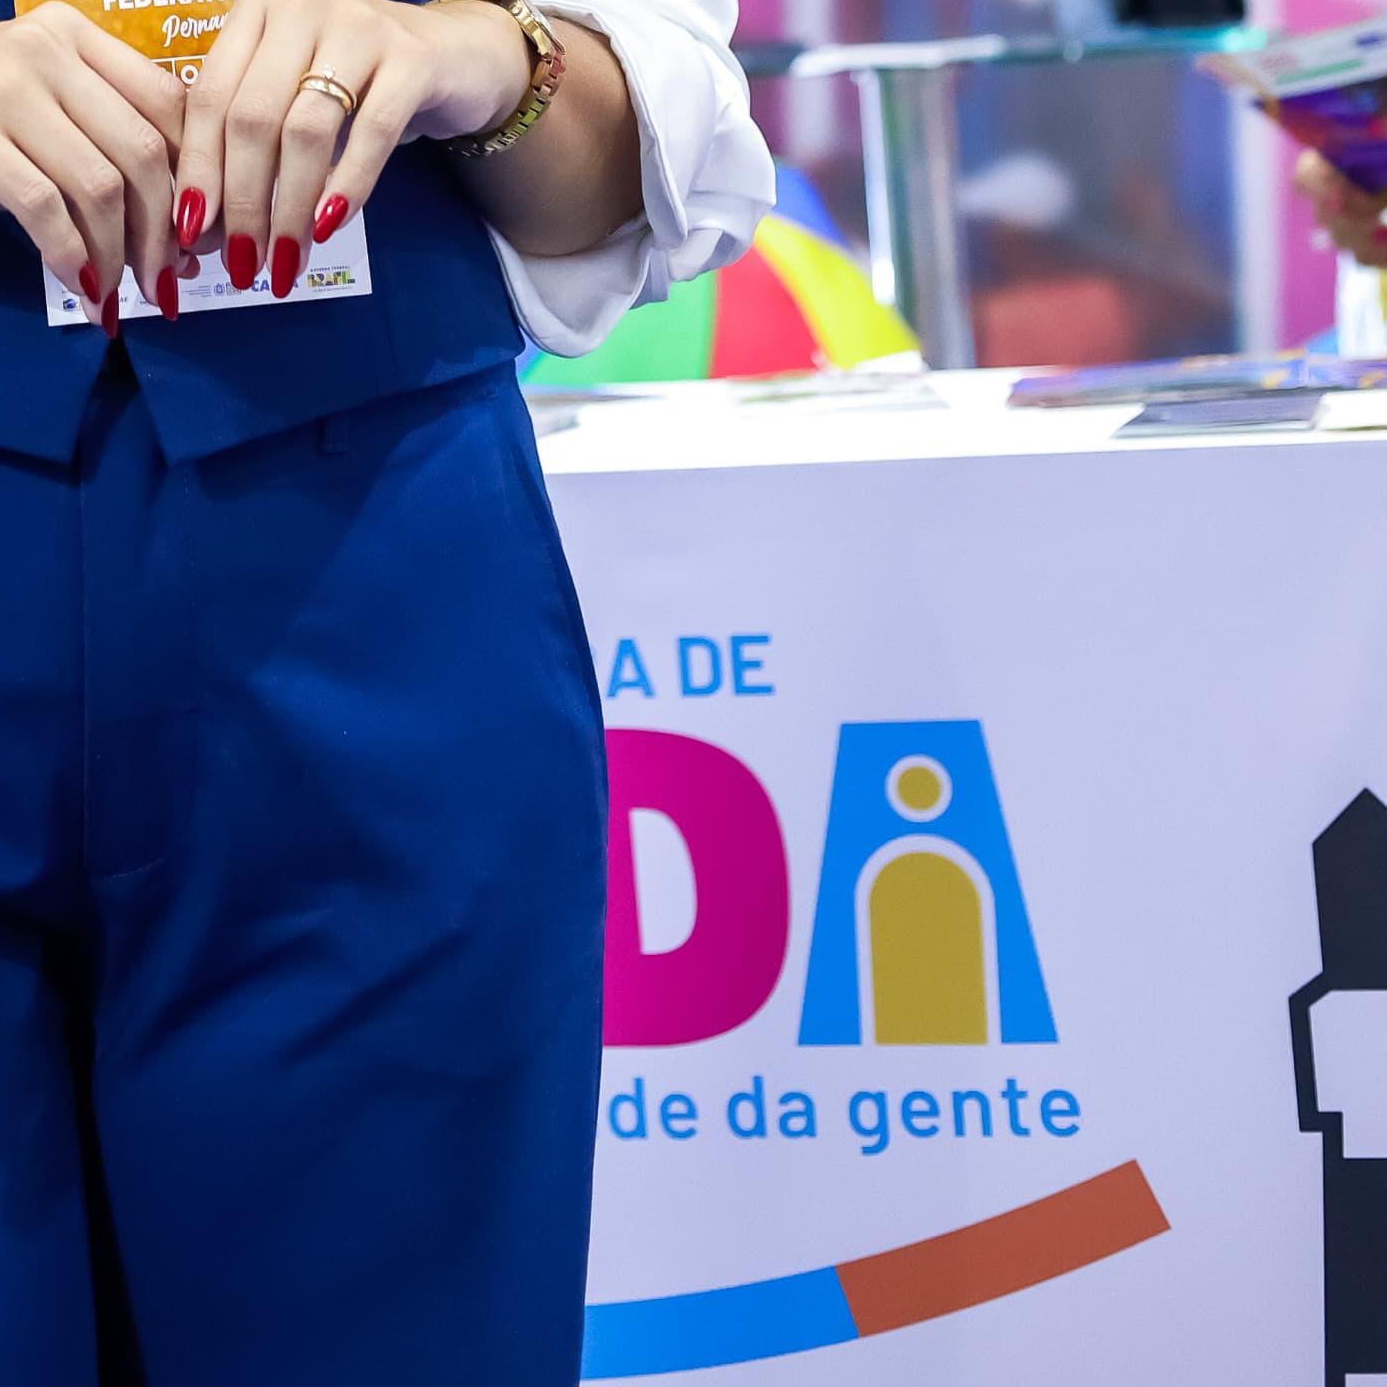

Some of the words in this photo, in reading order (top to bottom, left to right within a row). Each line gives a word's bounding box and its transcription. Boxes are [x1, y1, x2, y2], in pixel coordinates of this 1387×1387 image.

[677, 634, 776, 697] DE
[726, 1075, 818, 1139] da
[847, 1078, 1082, 1157] gente
